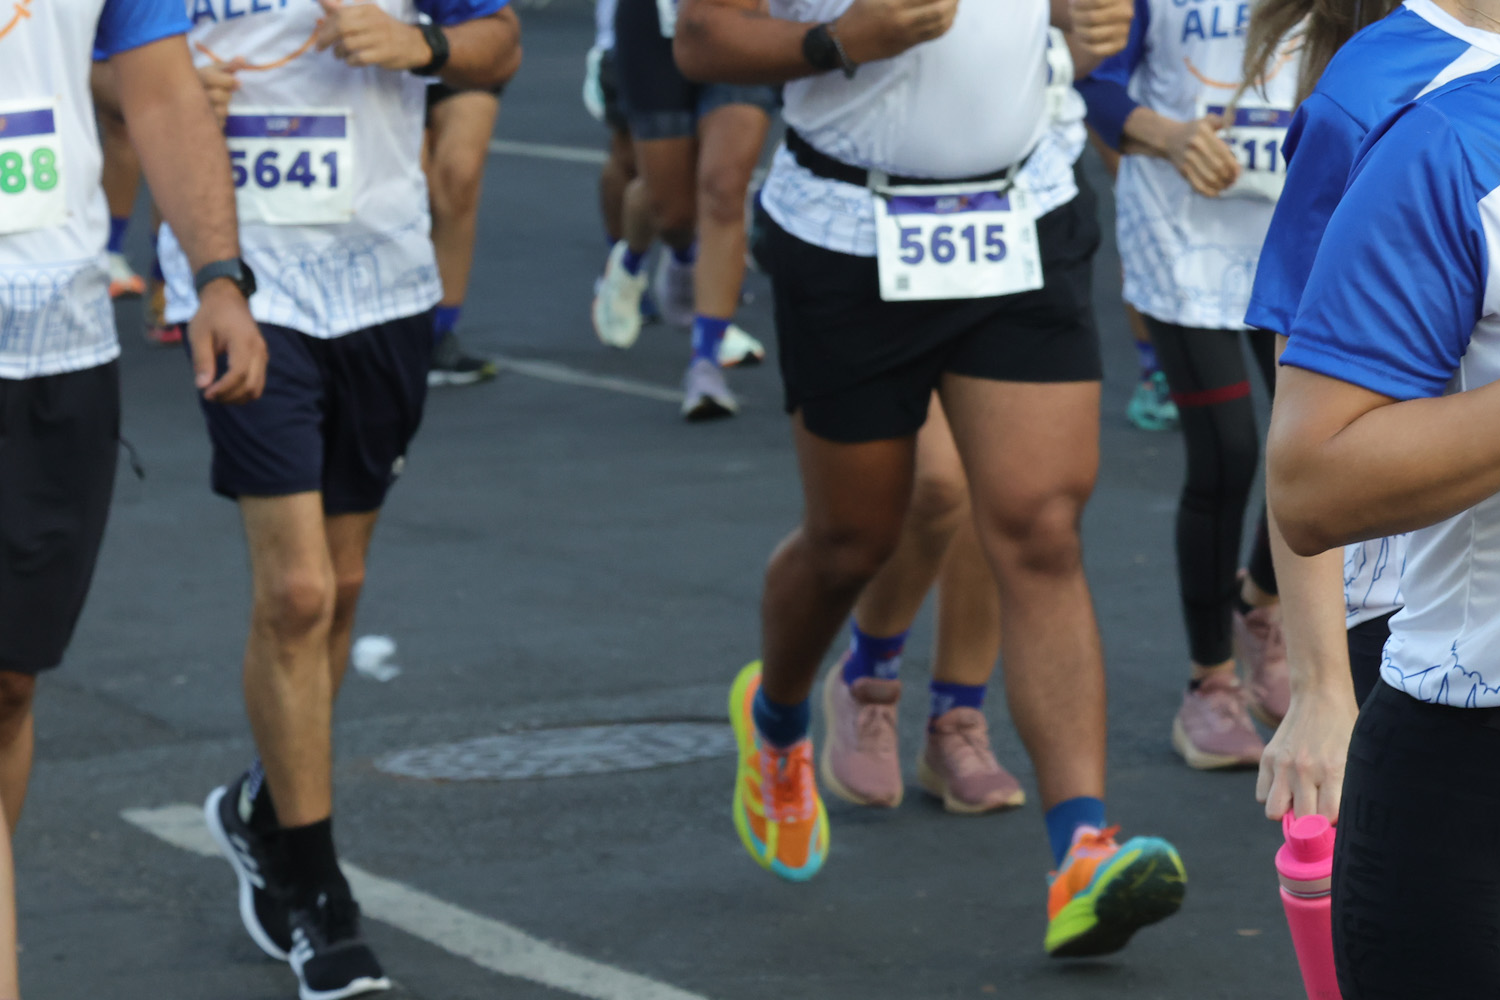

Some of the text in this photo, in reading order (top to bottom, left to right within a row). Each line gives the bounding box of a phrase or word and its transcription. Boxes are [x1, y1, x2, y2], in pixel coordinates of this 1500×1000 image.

[1181, 4, 1248, 44] ALE
[230, 150, 339, 189] 5641
[1224, 138, 1278, 173] 11
[899, 224, 1007, 266] 5615
